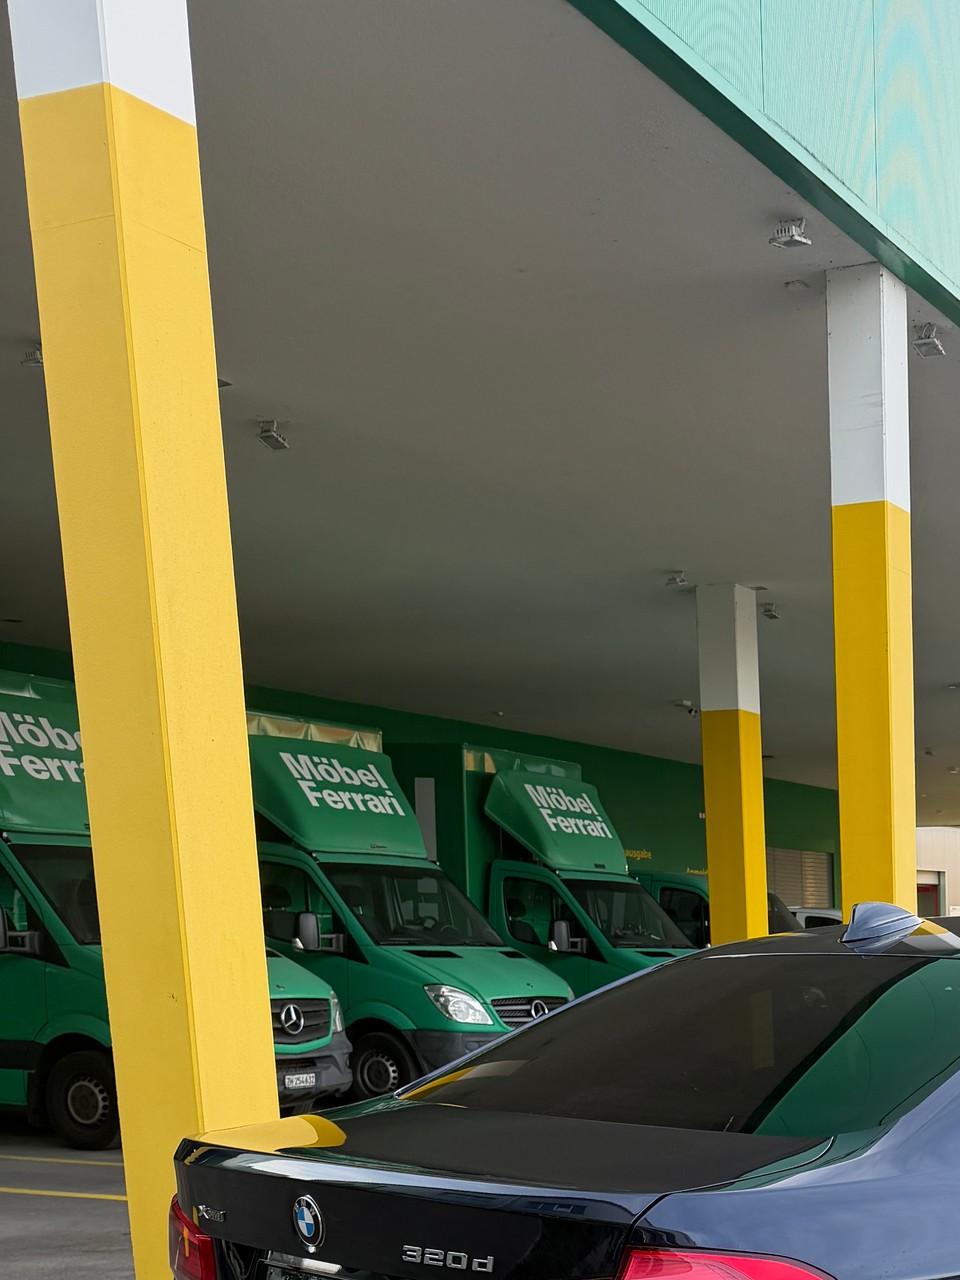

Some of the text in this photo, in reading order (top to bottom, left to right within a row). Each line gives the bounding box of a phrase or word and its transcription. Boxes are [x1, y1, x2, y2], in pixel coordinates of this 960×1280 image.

[279, 752, 389, 789] Möbel
[297, 779, 406, 817] Ferrari
[523, 783, 599, 815] Möbel
[539, 807, 613, 839] Ferrari
[402, 1244, 494, 1273] 320d
